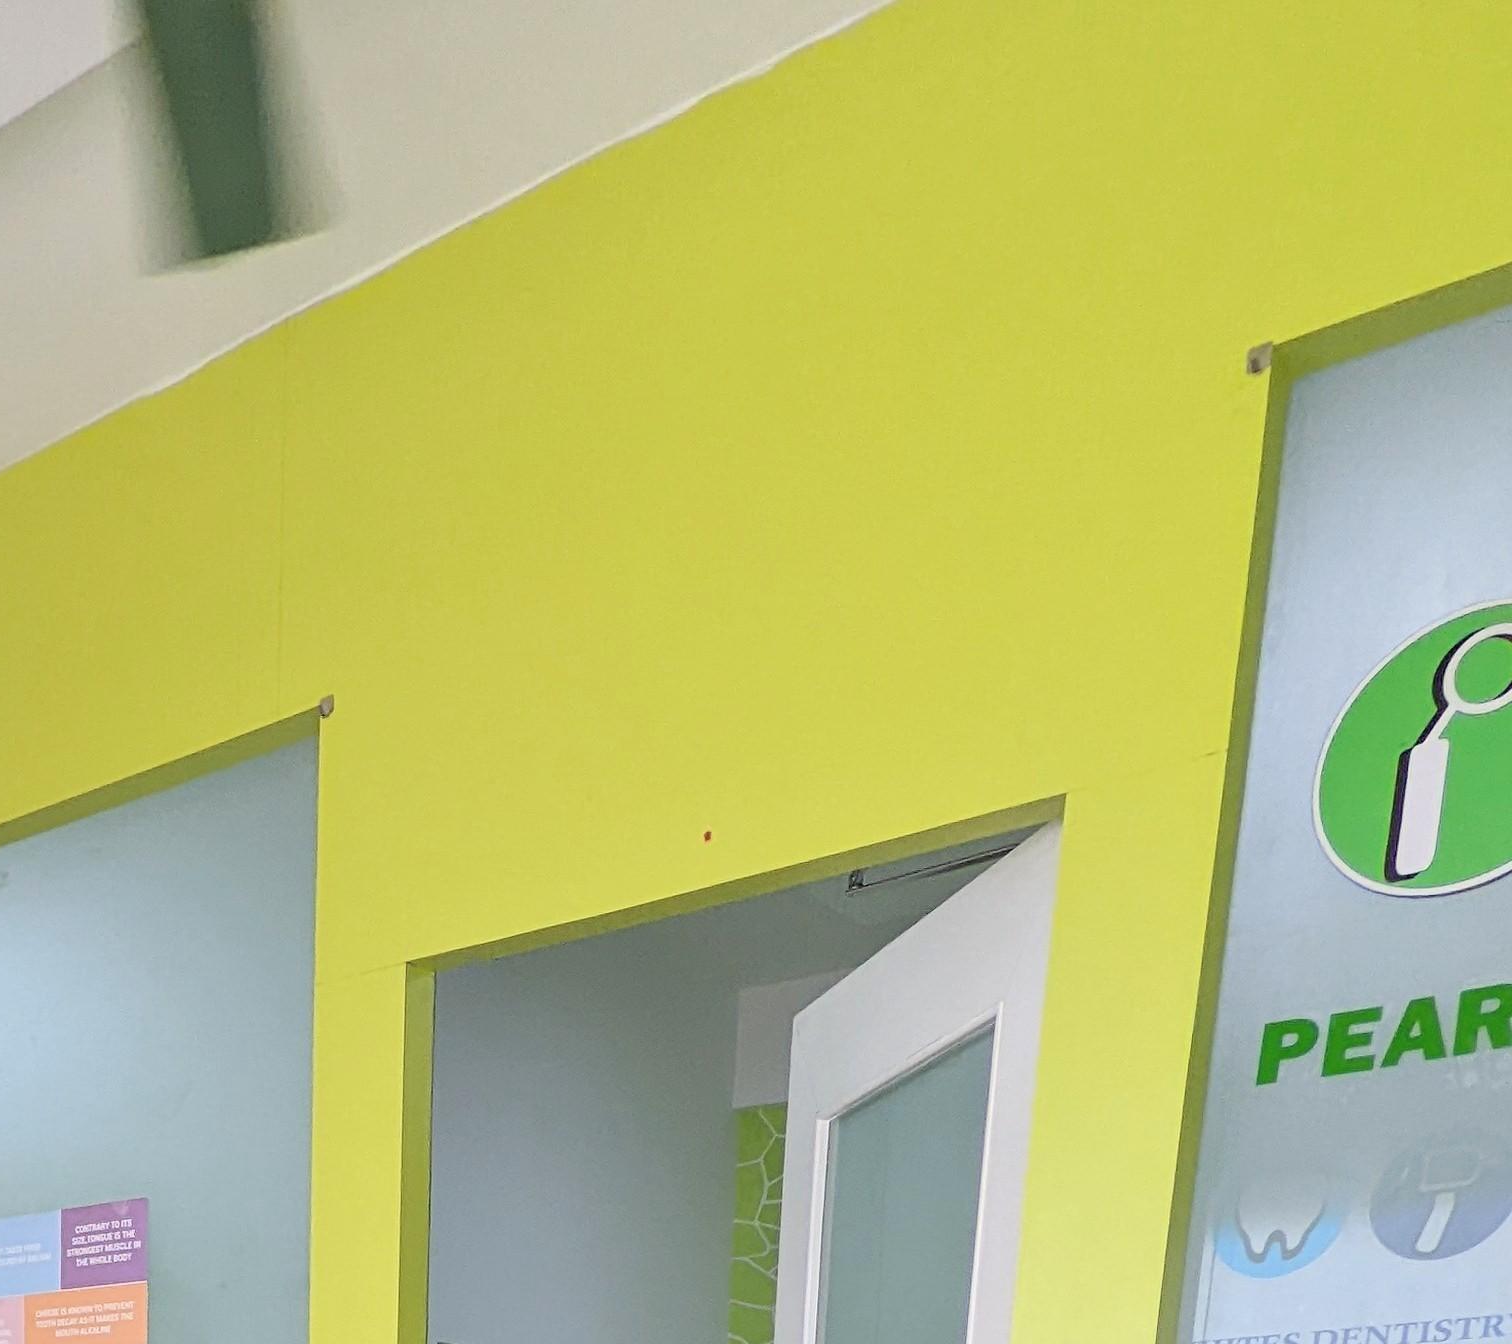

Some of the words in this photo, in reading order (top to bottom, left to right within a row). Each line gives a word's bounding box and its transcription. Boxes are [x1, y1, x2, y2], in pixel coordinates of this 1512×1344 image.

[122, 1229, 136, 1239] THE
[66, 1245, 104, 1258] STRONGEST
[104, 1241, 133, 1252] MUSCLE
[76, 1257, 89, 1267] THE
[113, 1253, 133, 1263] BODY
